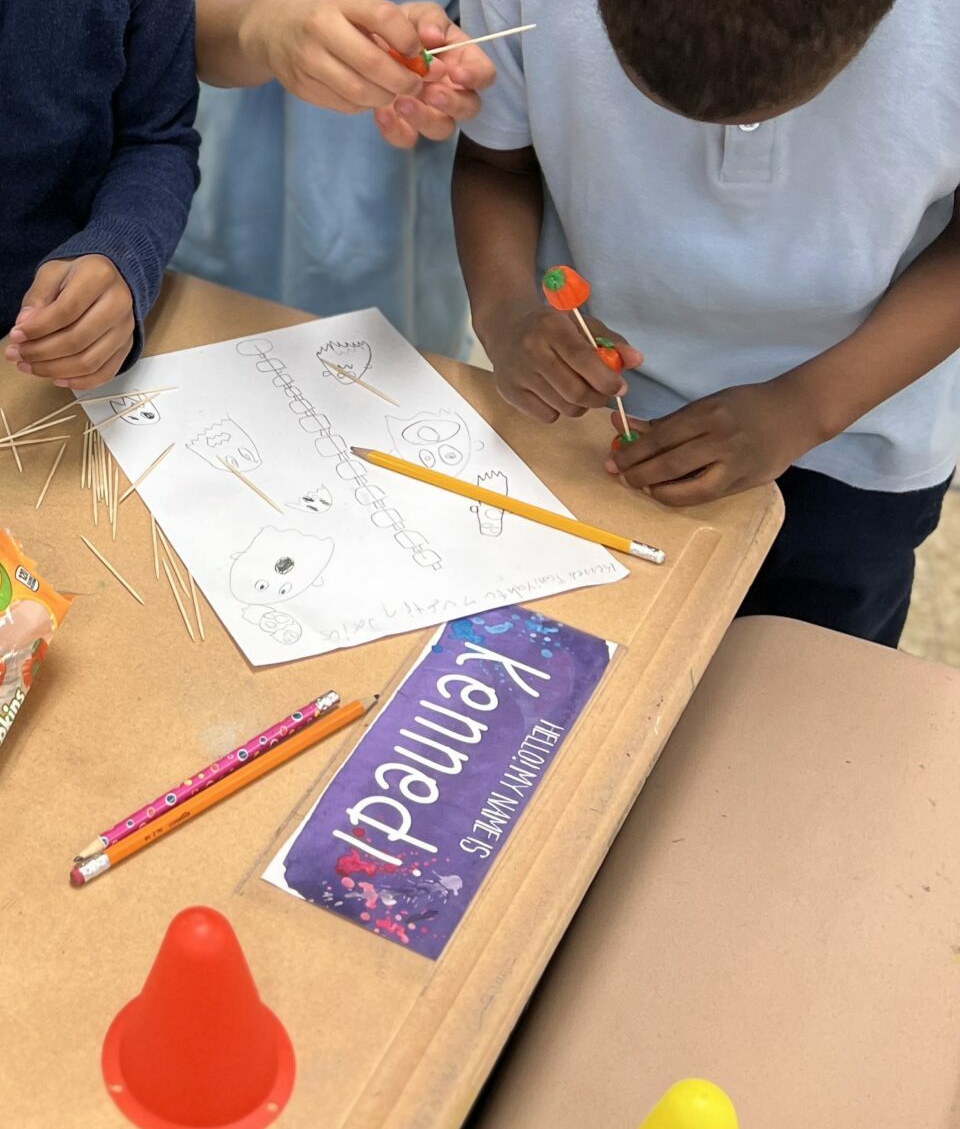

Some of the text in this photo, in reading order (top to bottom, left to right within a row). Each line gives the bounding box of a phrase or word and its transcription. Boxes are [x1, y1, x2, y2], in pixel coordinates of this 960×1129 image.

[459, 718, 565, 859] HELLO! MY NAME IS
